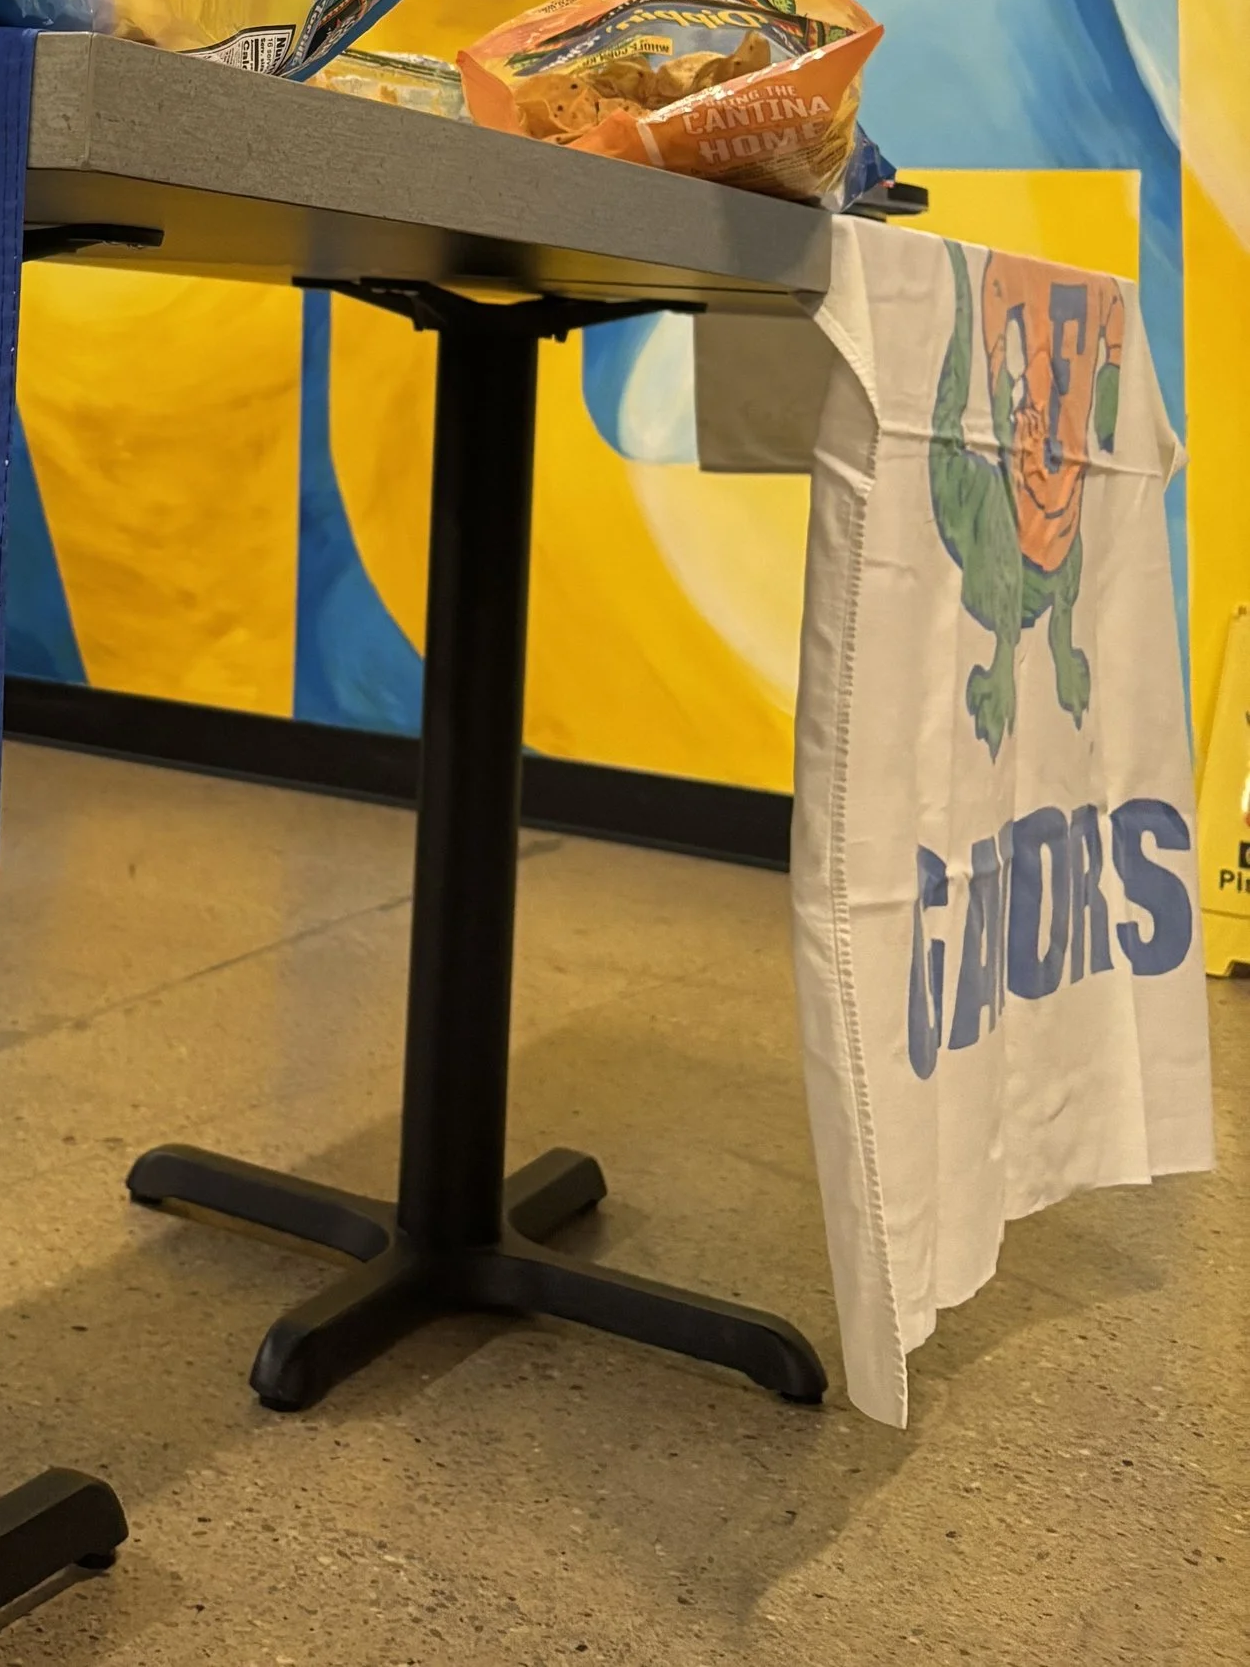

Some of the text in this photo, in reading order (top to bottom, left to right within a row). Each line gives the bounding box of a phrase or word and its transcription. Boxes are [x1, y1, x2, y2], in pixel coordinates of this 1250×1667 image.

[766, 85, 798, 98] THE
[681, 96, 831, 136] CANTINA
[699, 117, 827, 166] HOME
